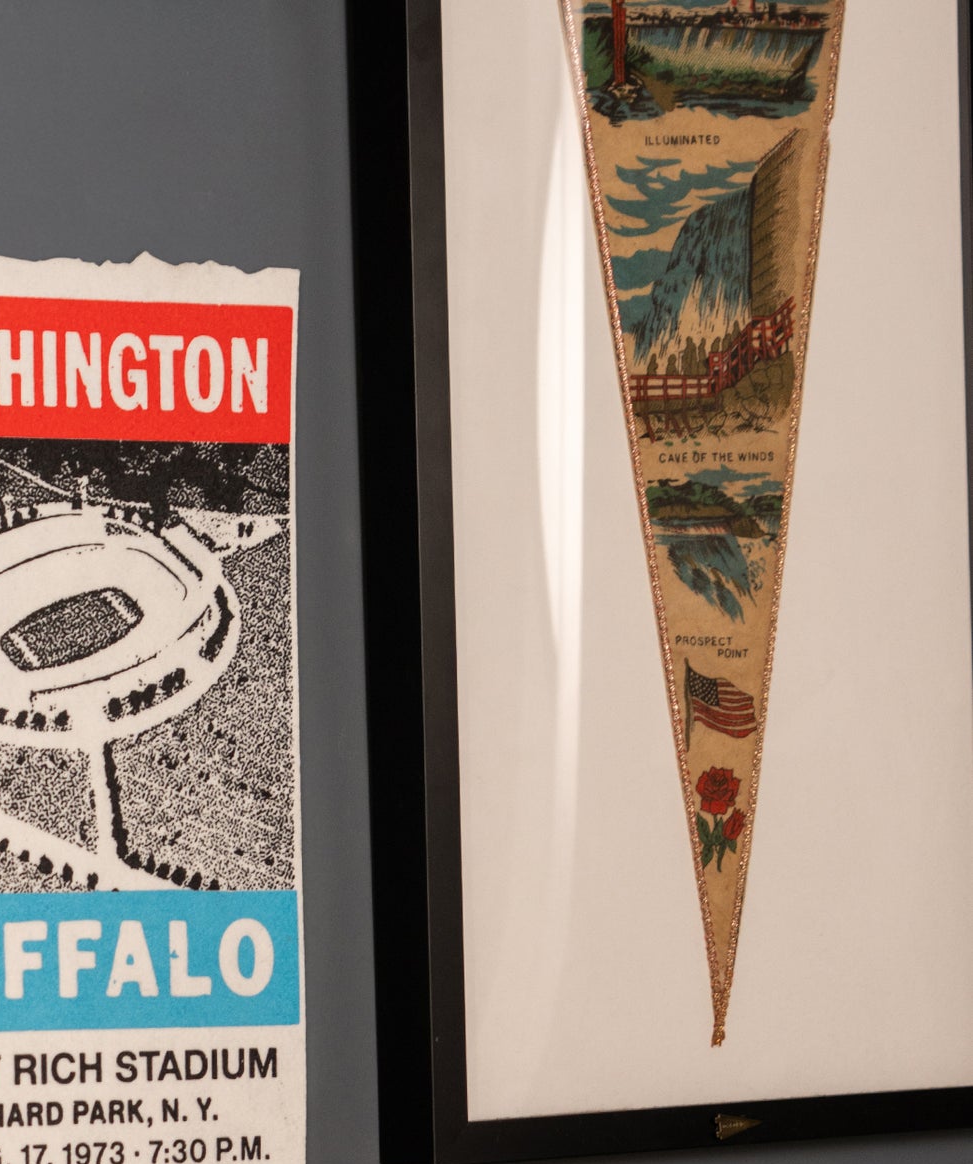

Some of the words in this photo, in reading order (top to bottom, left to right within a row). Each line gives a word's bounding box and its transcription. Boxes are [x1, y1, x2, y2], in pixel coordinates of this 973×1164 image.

[644, 133, 721, 147] ILLUMINATED
[659, 453, 689, 464] CAVE
[692, 451, 706, 463] OF
[712, 452, 734, 463] THE
[738, 451, 774, 462] WINDS
[675, 636, 732, 647] PROSPECT
[717, 648, 749, 658] POINT
[13, 1050, 103, 1084] RICH
[115, 1046, 279, 1083] STADIUM
[72, 1098, 153, 1128] PARK,
[161, 1098, 188, 1123] N.
[195, 1096, 219, 1122] Y.
[148, 1139, 207, 1164] 7:30
[215, 1135, 271, 1163] P.M.
